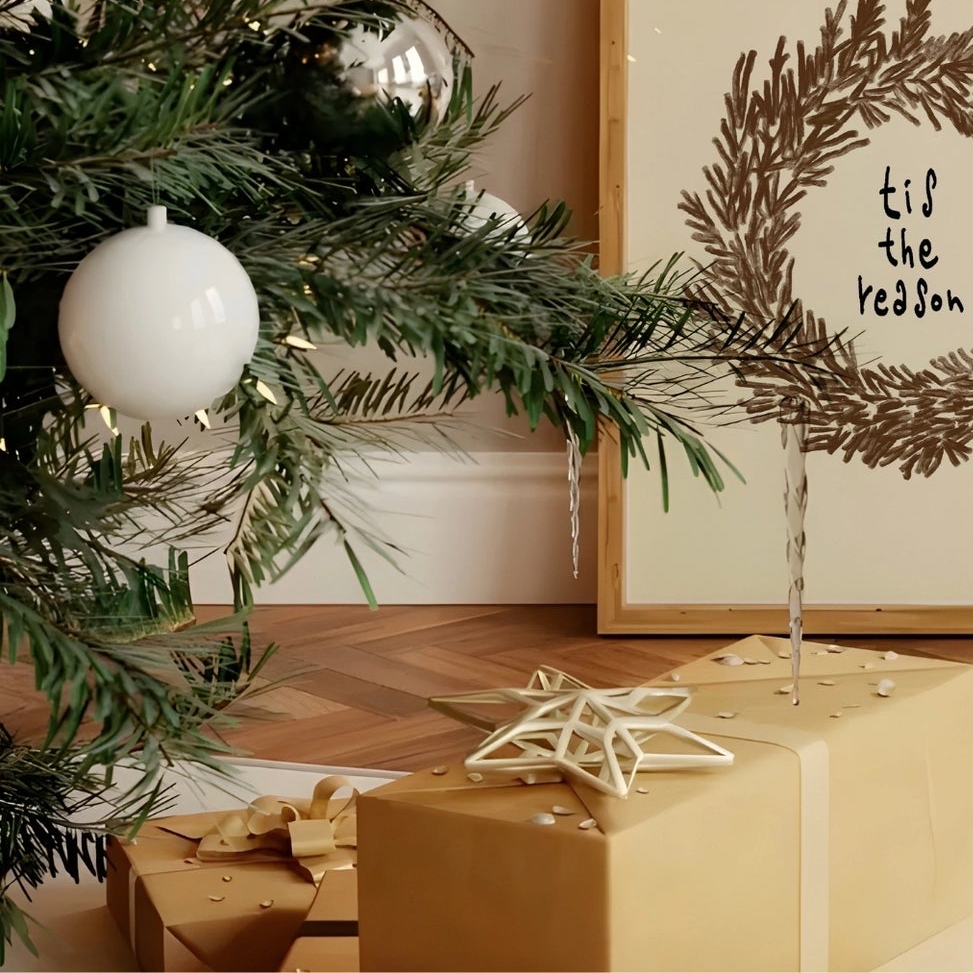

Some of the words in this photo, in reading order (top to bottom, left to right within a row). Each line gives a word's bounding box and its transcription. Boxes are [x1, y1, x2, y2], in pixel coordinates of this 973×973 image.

[878, 165, 938, 220] tis
[877, 226, 939, 270] the
[857, 274, 965, 319] reason
